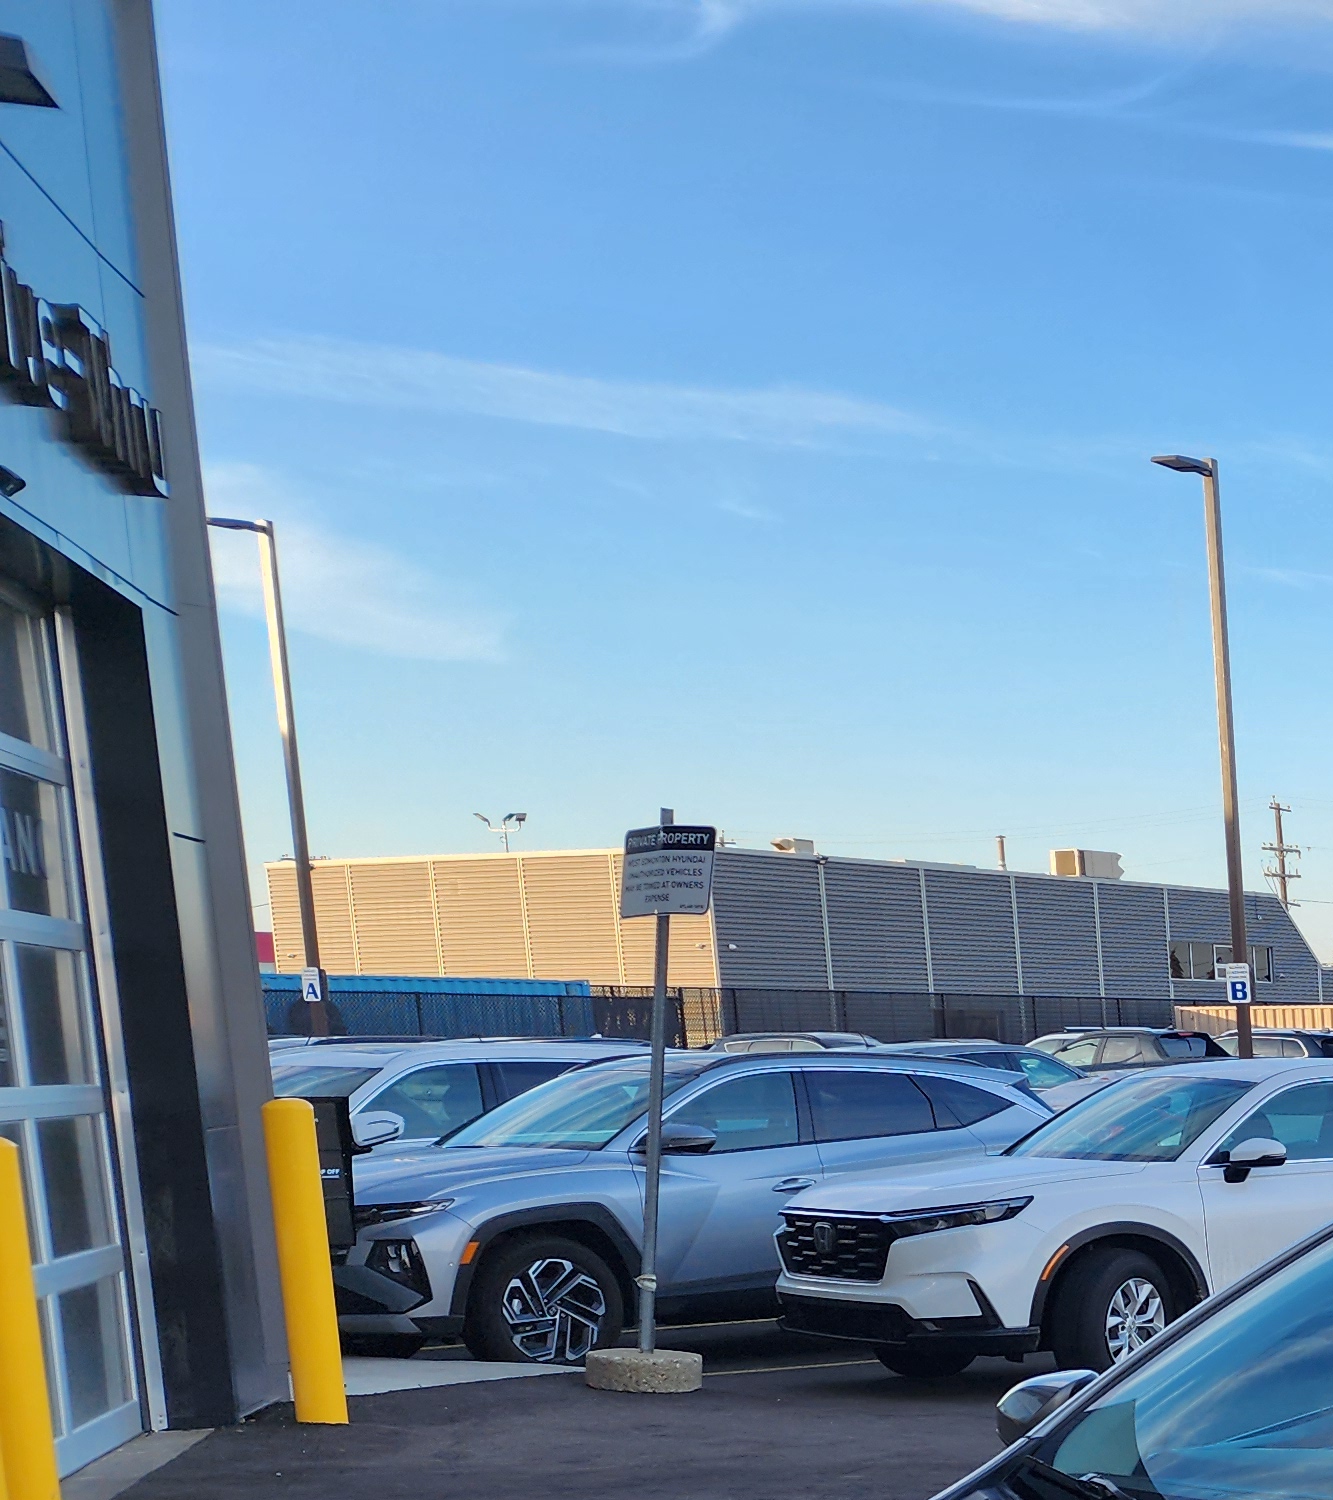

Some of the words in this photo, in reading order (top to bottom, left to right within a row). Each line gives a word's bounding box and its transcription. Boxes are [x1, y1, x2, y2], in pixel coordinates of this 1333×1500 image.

[657, 831, 710, 846] PROPERTY
[672, 855, 706, 864] HYUNDAI
[666, 868, 703, 877] VEHICLES
[661, 880, 670, 889] AT
[671, 881, 704, 889] OWNERS
[305, 983, 320, 999] A
[1230, 981, 1248, 1000] B
